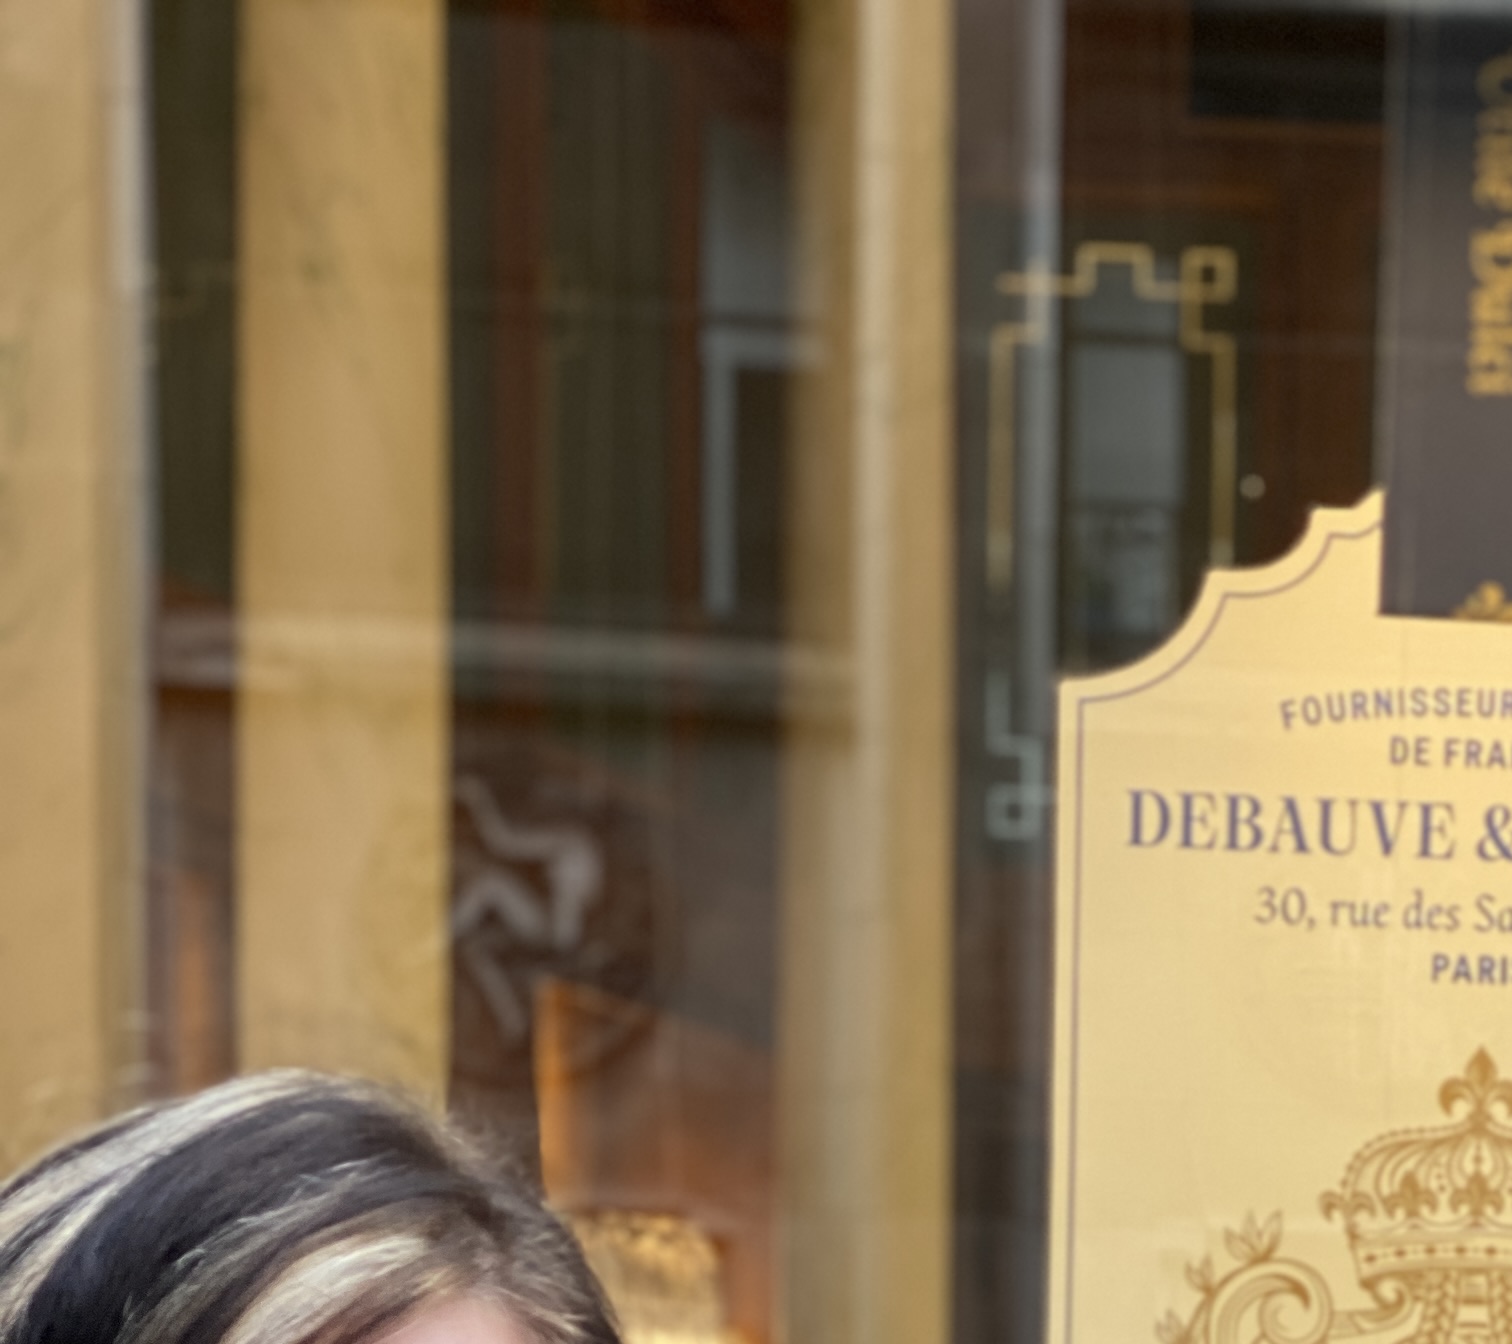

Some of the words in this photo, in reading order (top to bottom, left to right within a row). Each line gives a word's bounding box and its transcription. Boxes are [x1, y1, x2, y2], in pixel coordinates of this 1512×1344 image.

[1389, 735, 1432, 768] DE
[1125, 788, 1457, 862] DEBAUVE
[1253, 885, 1316, 932] 30,
[1328, 897, 1392, 930] rue
[1403, 888, 1462, 932] des
